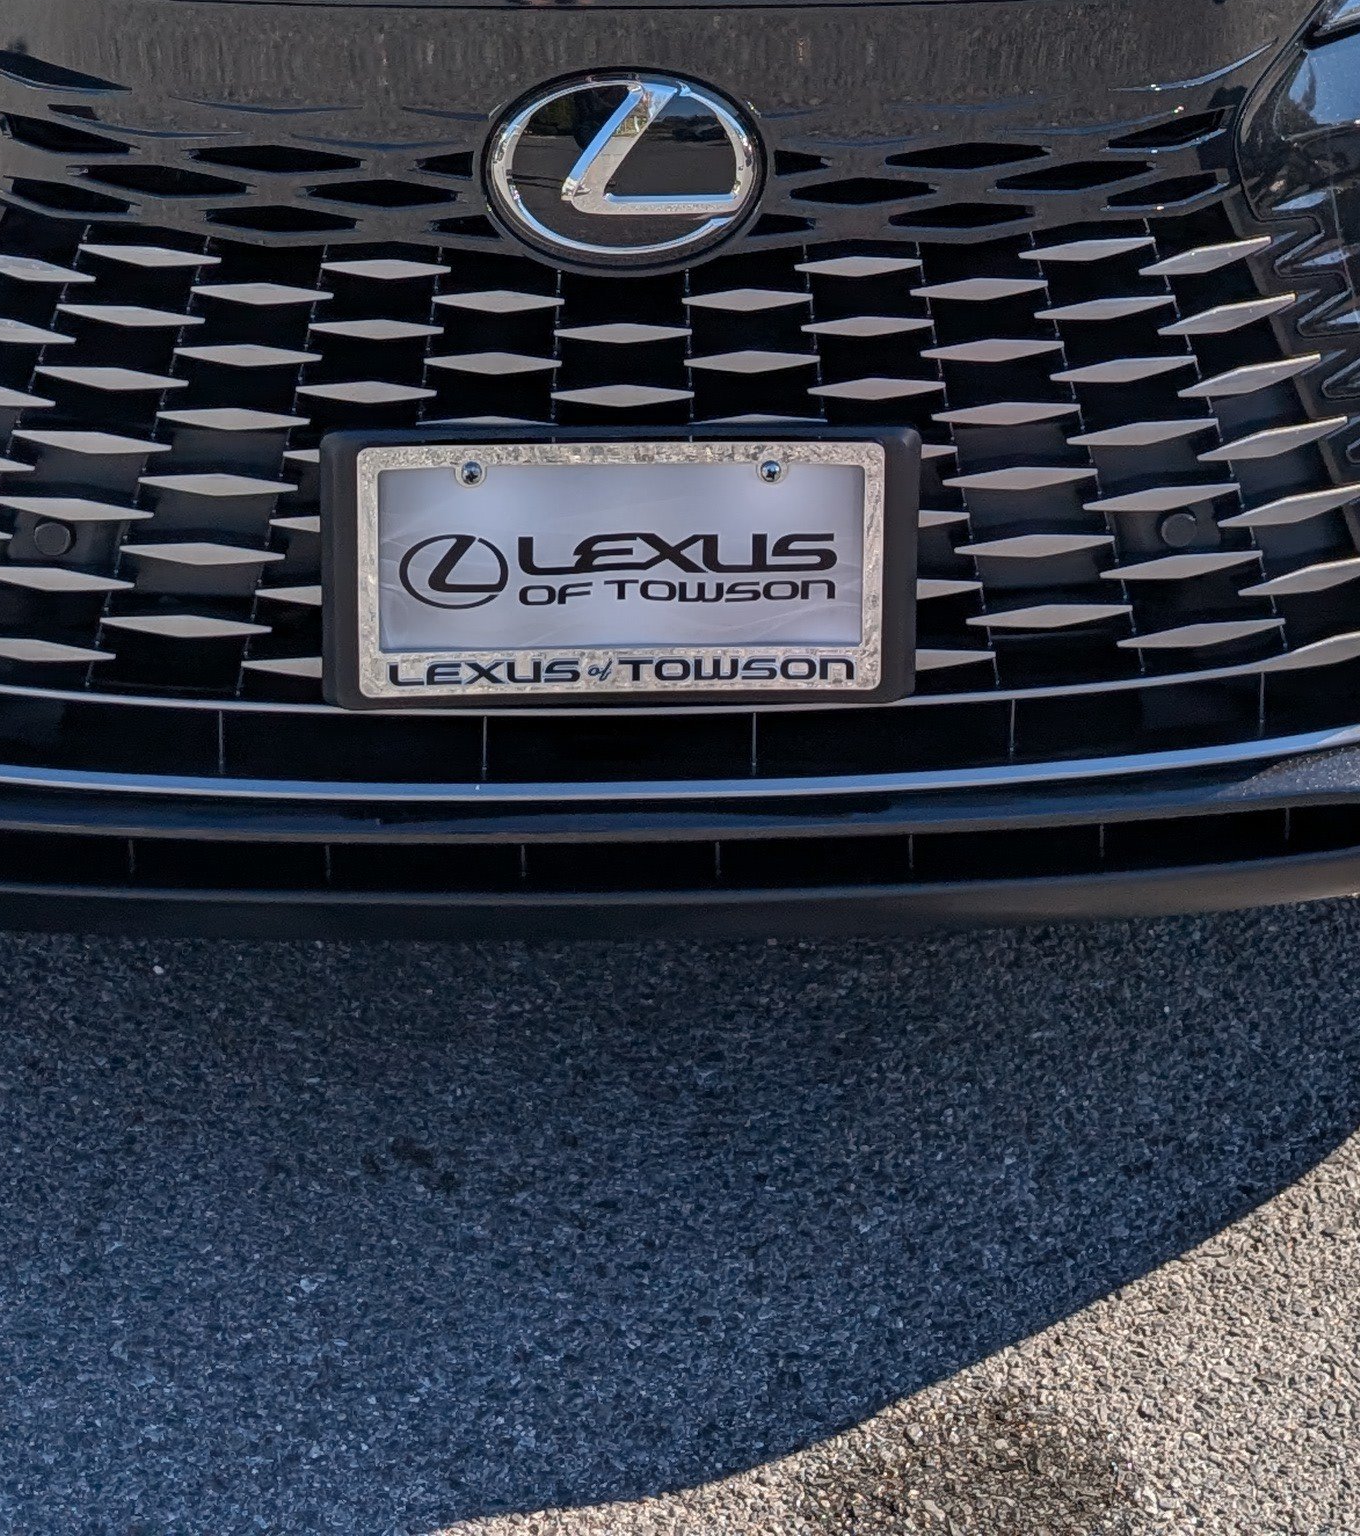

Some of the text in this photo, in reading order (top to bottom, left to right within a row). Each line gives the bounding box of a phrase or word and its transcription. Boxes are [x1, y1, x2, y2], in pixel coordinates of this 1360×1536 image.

[517, 531, 839, 576] LEXUS
[518, 578, 837, 606] OF TOWSON
[387, 656, 856, 687] LEXUS of TOWSON
